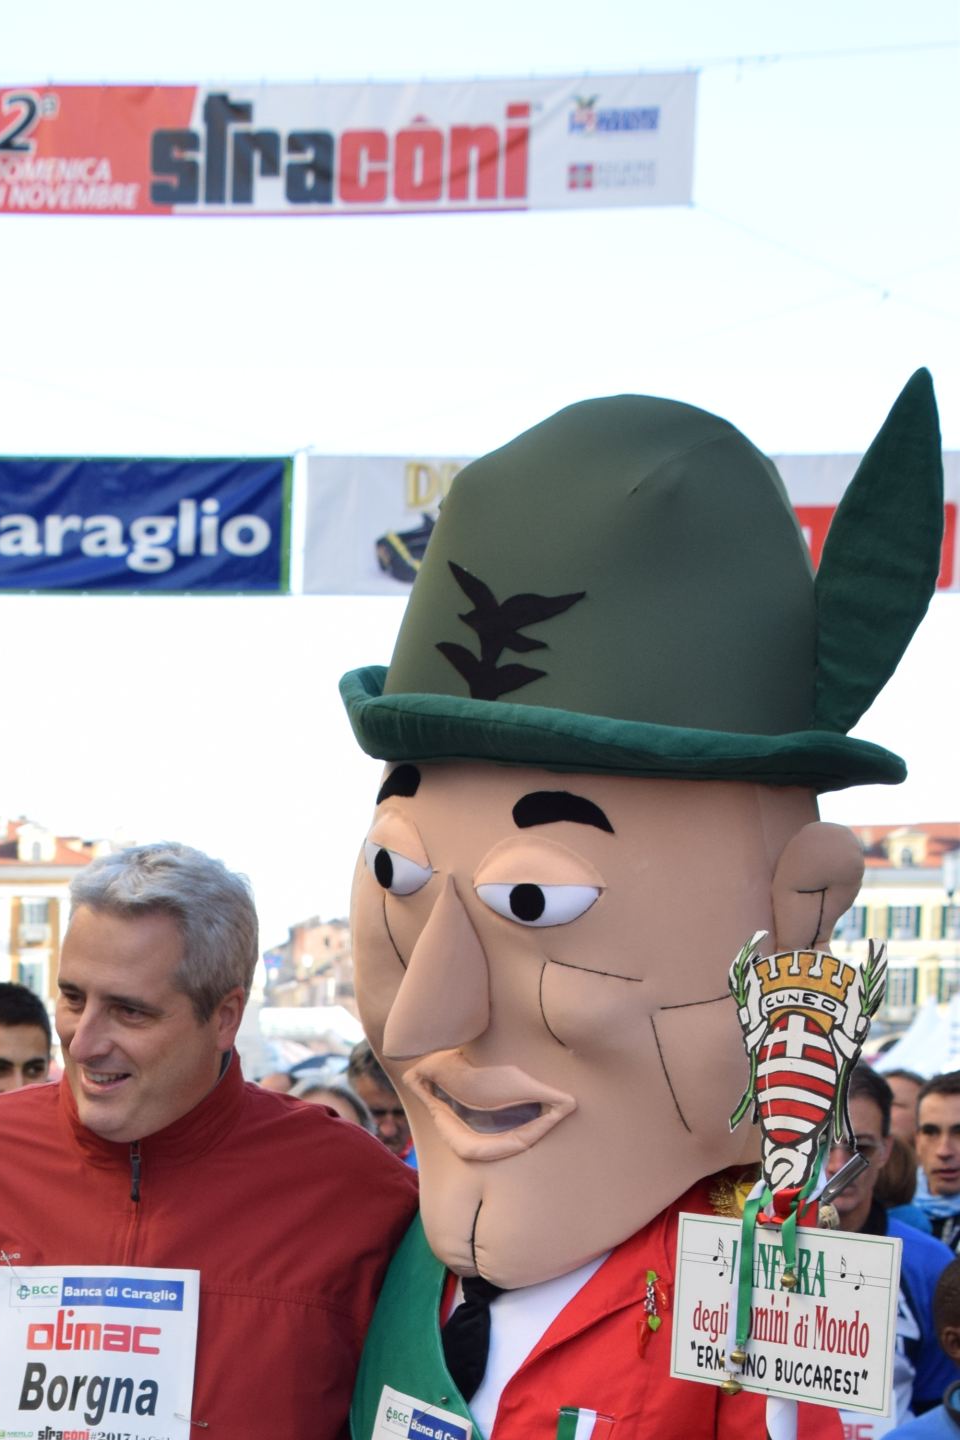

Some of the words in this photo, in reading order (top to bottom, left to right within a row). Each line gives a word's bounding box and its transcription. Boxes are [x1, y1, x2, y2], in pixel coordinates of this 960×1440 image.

[8, 182, 138, 209] NOVEMBRE
[766, 992, 836, 1012] CUNEO
[32, 1285, 58, 1295] BCC
[64, 1286, 102, 1298] Banca
[106, 1286, 118, 1297] di
[122, 1288, 177, 1303] Caraglio
[26, 1309, 161, 1355] olimac
[693, 1300, 729, 1343] degli
[794, 1314, 809, 1348] di
[814, 1305, 869, 1358] Mondo
[775, 1358, 868, 1395] BUCCARESI"
[18, 1362, 159, 1426] Borgna
[393, 1410, 409, 1423] BCC
[411, 1419, 434, 1437] Banca
[435, 1428, 443, 1440] di
